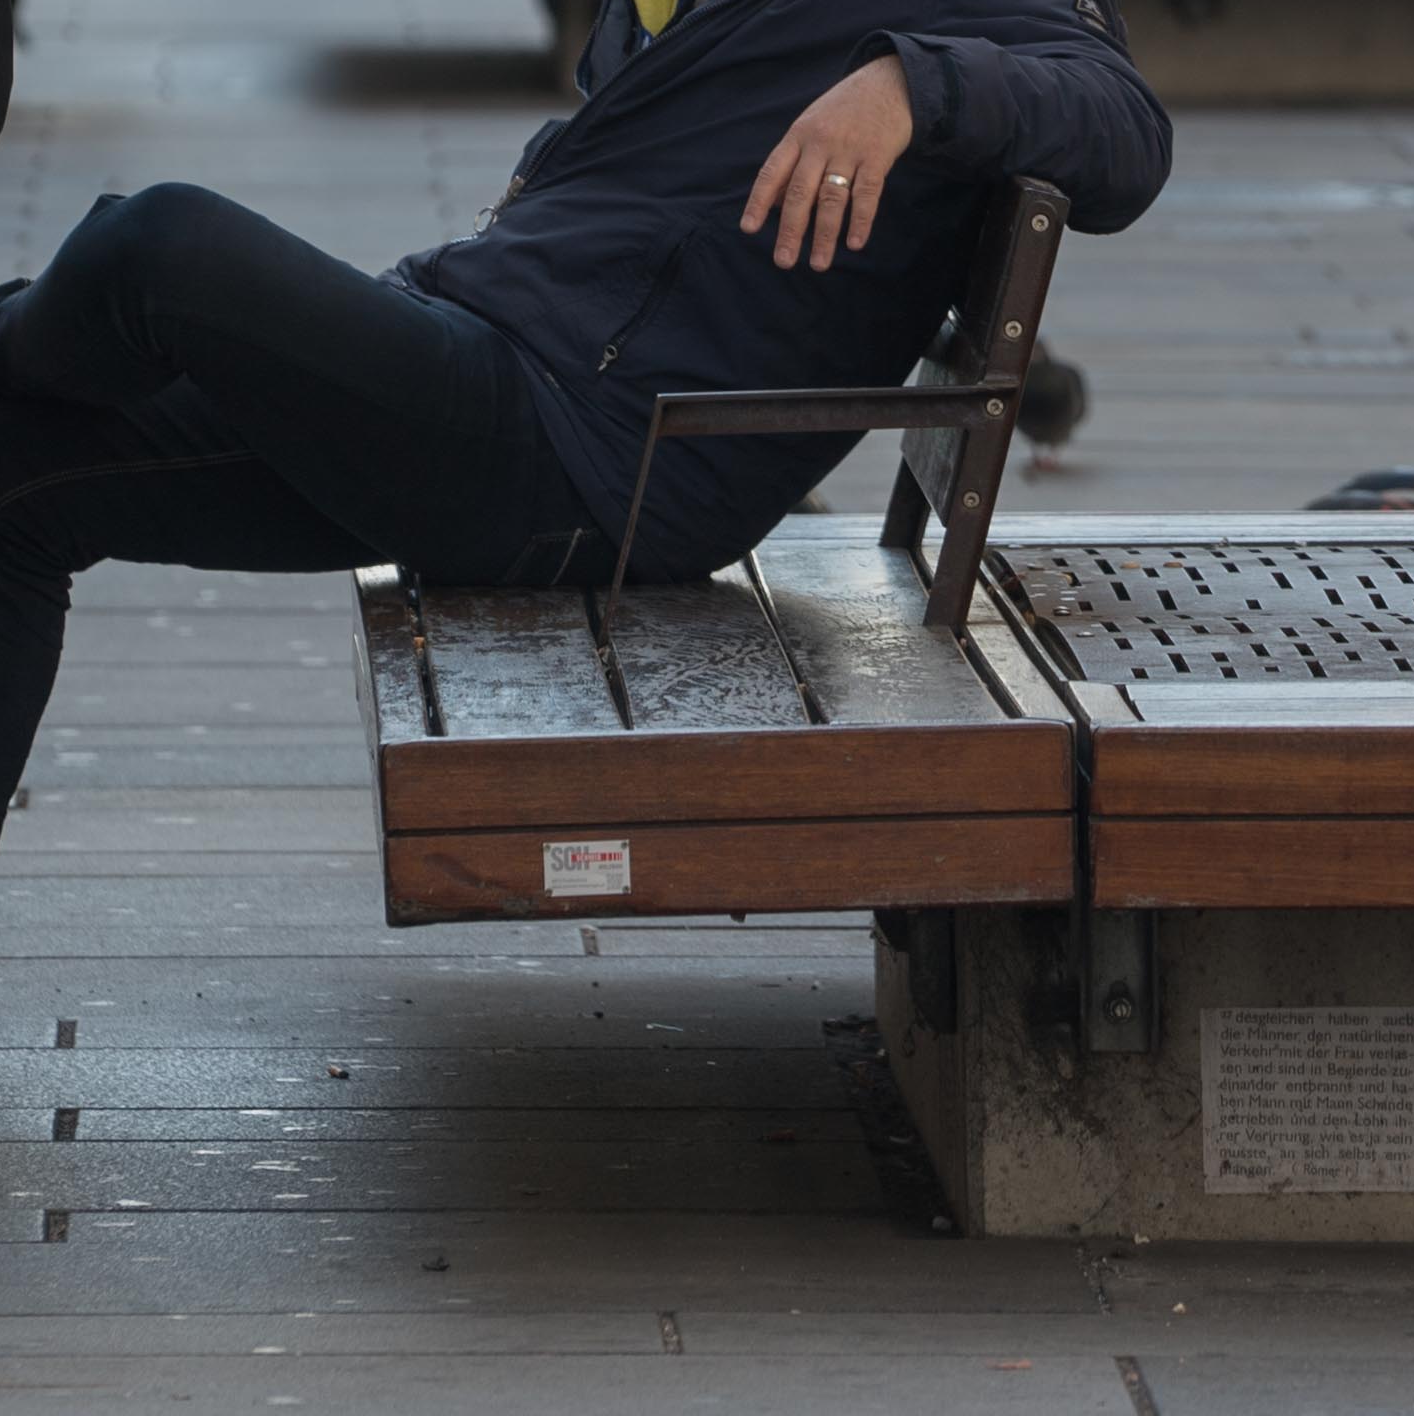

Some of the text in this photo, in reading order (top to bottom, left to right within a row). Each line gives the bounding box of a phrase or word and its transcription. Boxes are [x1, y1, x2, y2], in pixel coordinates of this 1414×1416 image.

[1236, 1011, 1314, 1030] desgleichen
[1328, 1012, 1368, 1026] haben
[1221, 1028, 1241, 1041] die
[1307, 1030, 1331, 1042] den
[1221, 1046, 1273, 1058] Verkehr
[1280, 1047, 1301, 1058] mit
[1307, 1048, 1328, 1059] der
[1335, 1047, 1364, 1059] Frau
[1220, 1064, 1242, 1074] sen
[1248, 1062, 1272, 1074] und
[1279, 1062, 1305, 1075] sind
[1311, 1063, 1322, 1075] in
[1328, 1063, 1386, 1079] Begierde
[1219, 1079, 1278, 1092] einander
[1286, 1079, 1354, 1092] entbrannt
[1360, 1079, 1385, 1093] und
[1220, 1095, 1413, 1110] ben Mann mit Mann Schande
[1220, 1113, 1283, 1128] getrieben
[1291, 1113, 1316, 1126] und
[1323, 1113, 1347, 1126] den
[1355, 1113, 1387, 1126] Lohn
[1219, 1130, 1239, 1141] rer
[1320, 1129, 1343, 1143] wie
[1350, 1133, 1365, 1143] es
[1369, 1130, 1379, 1146] ja
[1385, 1130, 1412, 1144] sein
[1280, 1149, 1296, 1159] an
[1304, 1145, 1329, 1159] sich
[1338, 1146, 1376, 1160] selbst
